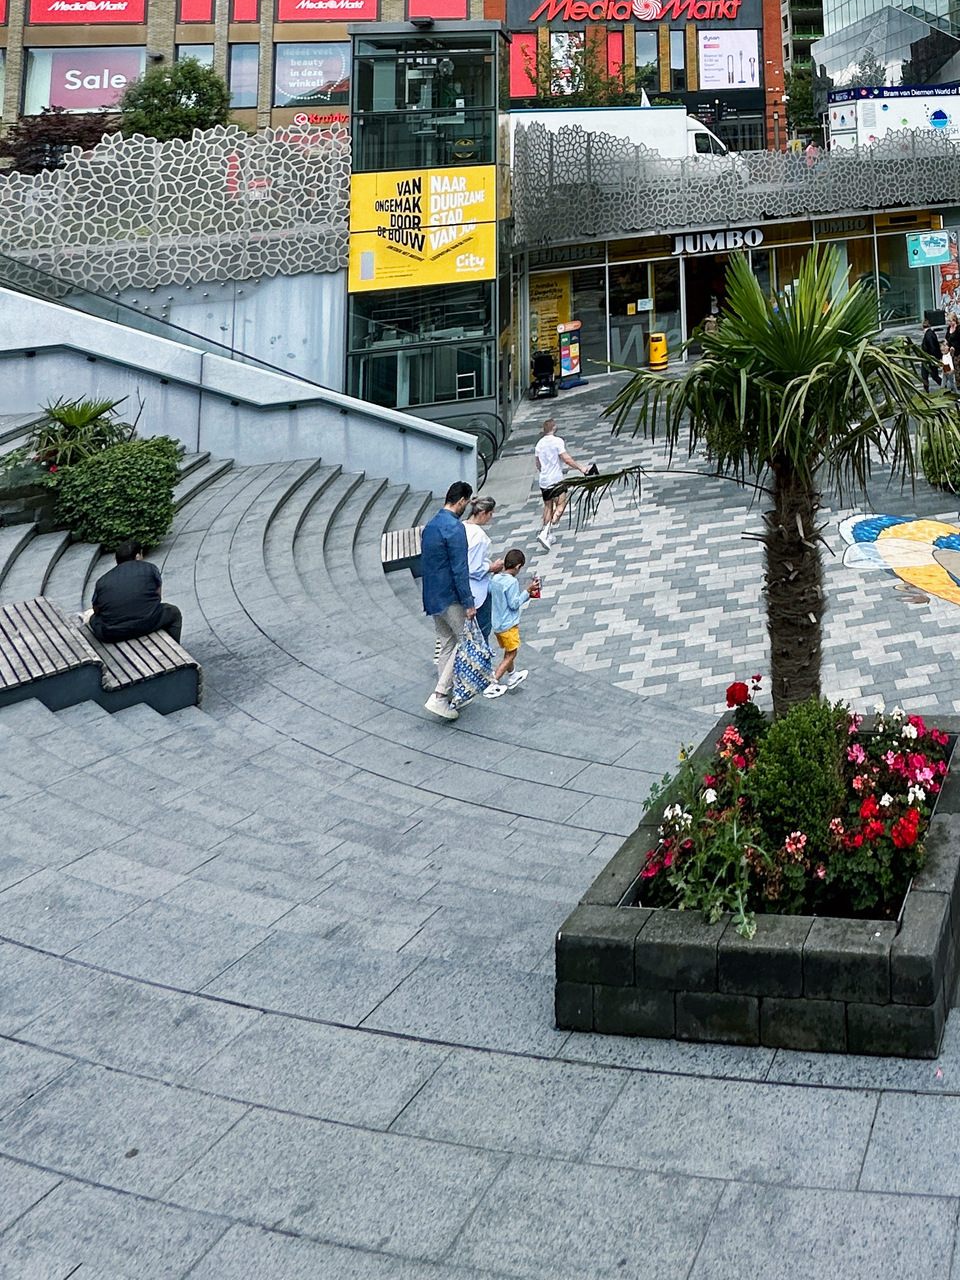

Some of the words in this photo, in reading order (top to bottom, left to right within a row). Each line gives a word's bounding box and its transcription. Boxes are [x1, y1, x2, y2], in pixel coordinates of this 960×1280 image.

[290, 59, 324, 67] beauty
[64, 69, 127, 90] Sale
[290, 69, 299, 77] in
[301, 69, 323, 77] deze
[397, 177, 422, 196] VAN
[430, 175, 467, 194] NAAR
[375, 196, 422, 214] ONGEMAK
[430, 190, 485, 213] DUURZAME
[390, 213, 422, 232] DOOR
[430, 208, 463, 232] STAD
[815, 218, 867, 234] JUMBO
[377, 226, 387, 238] DE
[388, 228, 425, 252] BOUW
[429, 225, 458, 251] VAN
[671, 228, 764, 256] JUMBO
